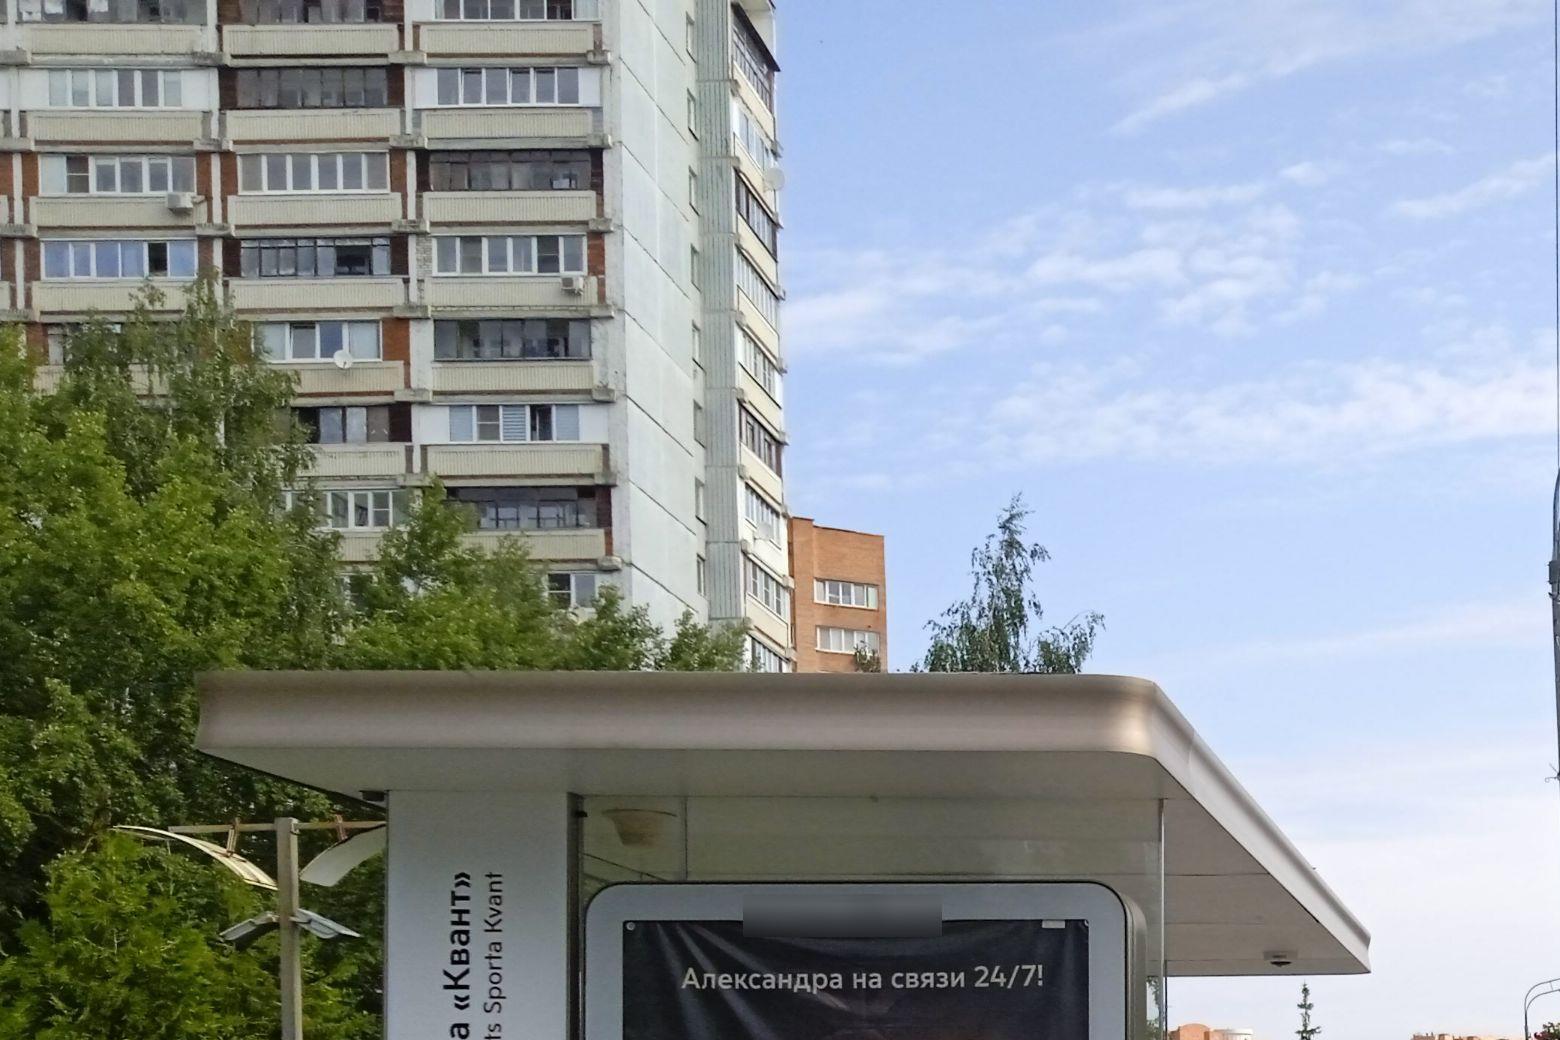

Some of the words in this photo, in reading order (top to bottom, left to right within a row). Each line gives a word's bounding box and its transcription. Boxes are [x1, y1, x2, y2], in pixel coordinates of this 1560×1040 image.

[484, 871, 503, 933] Kvant
[443, 871, 472, 1011] «Квант»
[483, 940, 507, 1014] Sporta
[681, 967, 843, 994] Александра
[852, 972, 882, 989] на
[891, 972, 965, 989] связи
[973, 964, 1044, 988] 24/7!
